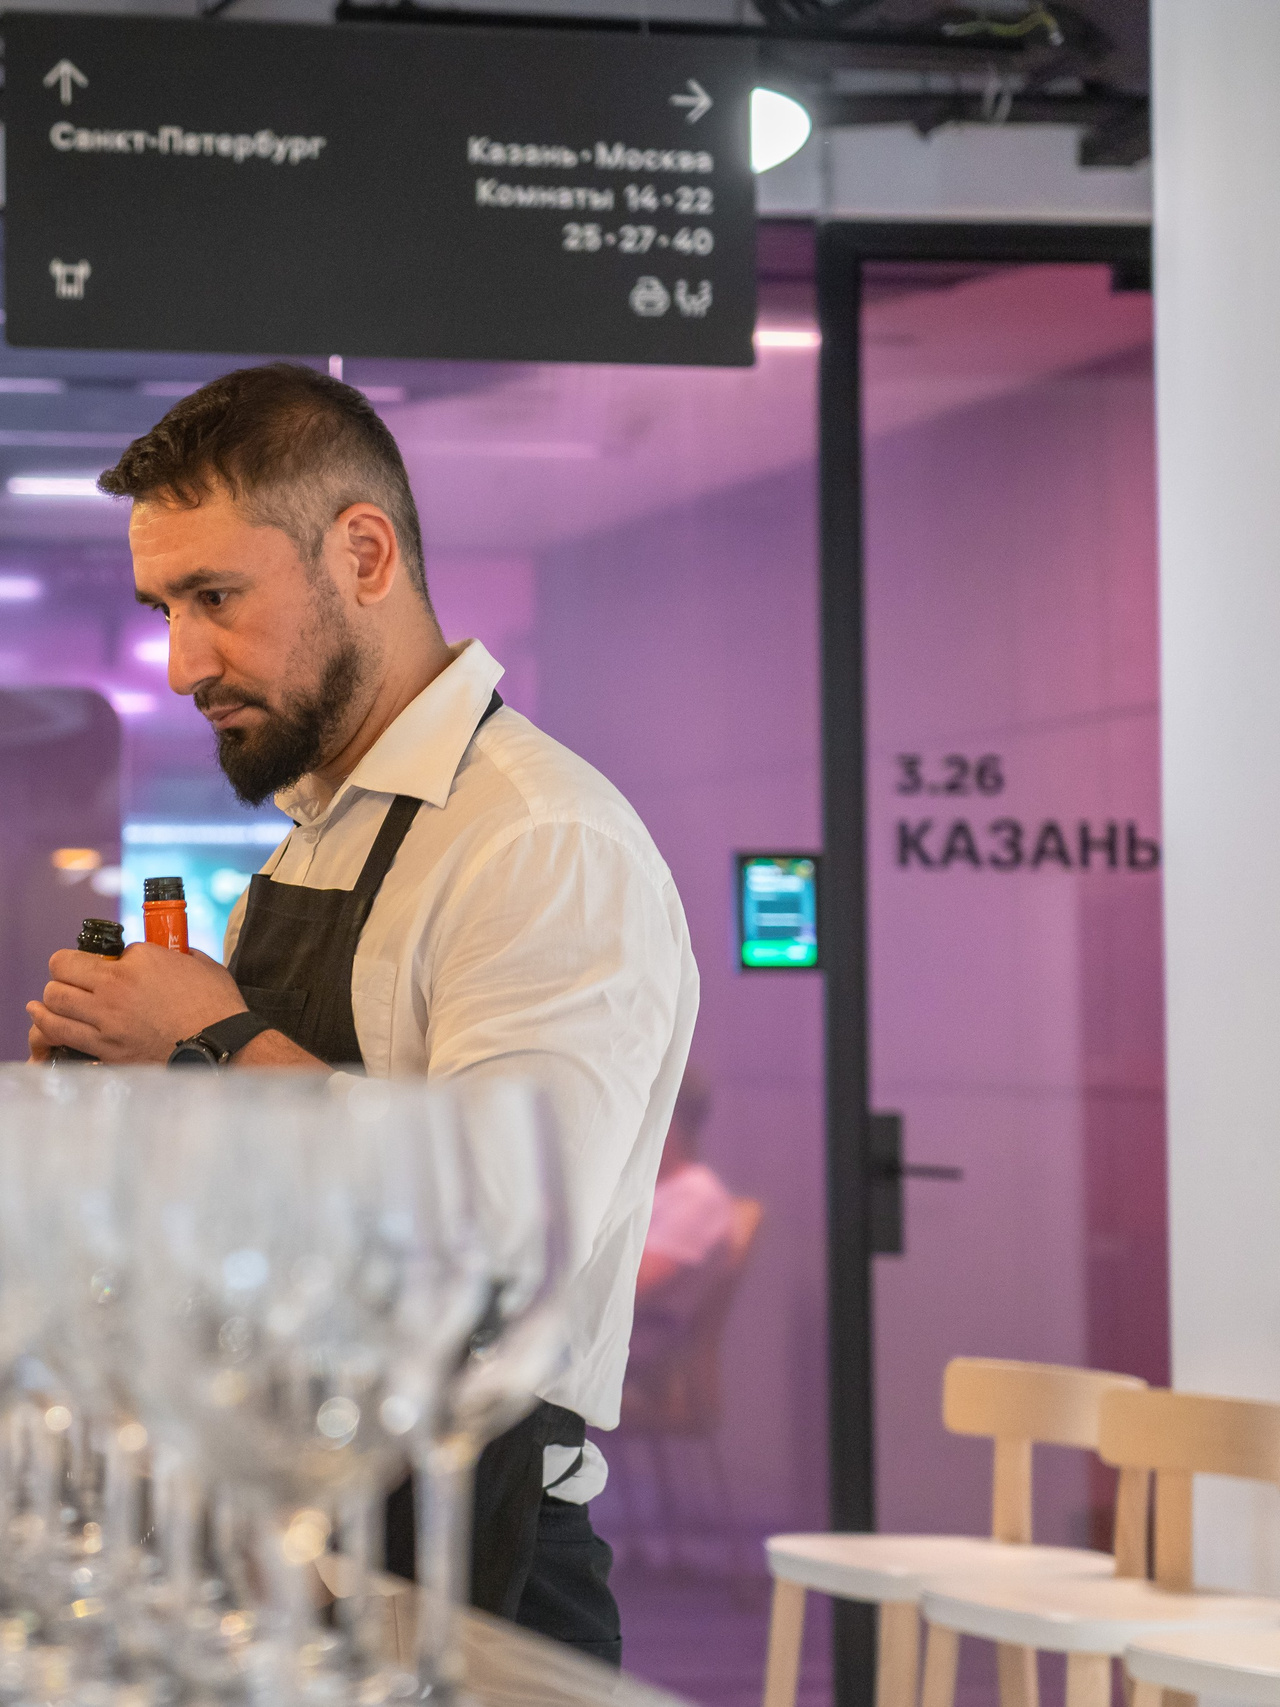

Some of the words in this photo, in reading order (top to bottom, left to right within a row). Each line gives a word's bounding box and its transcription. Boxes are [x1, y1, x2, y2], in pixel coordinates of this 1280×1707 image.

[49, 120, 327, 165] Санкт-Петербург
[476, 177, 615, 211] Комнаты
[896, 754, 1005, 796] 3.26
[896, 816, 1161, 871] КАЗАНЬ
